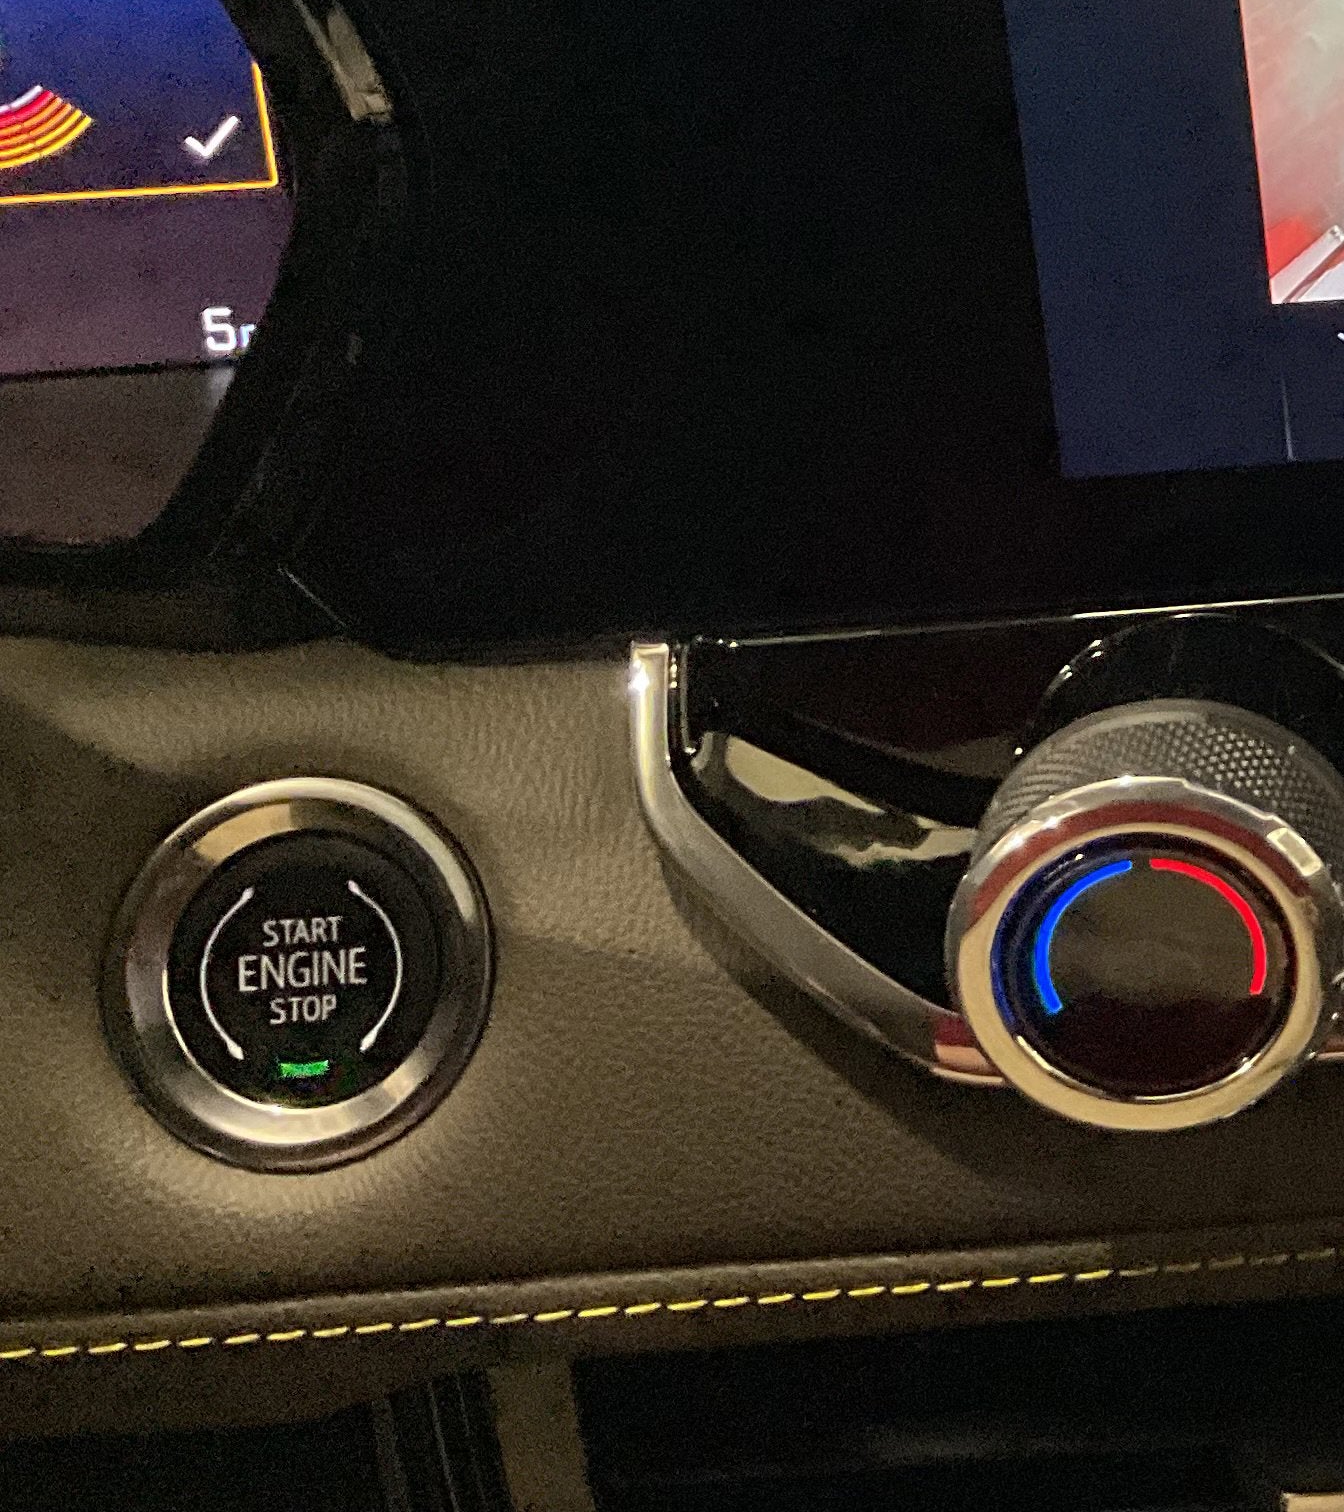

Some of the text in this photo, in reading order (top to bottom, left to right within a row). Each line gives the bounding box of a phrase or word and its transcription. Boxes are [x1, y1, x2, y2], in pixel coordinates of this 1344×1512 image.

[262, 915, 343, 948] START
[237, 946, 368, 993] ENGINE
[269, 993, 338, 1026] STOP
